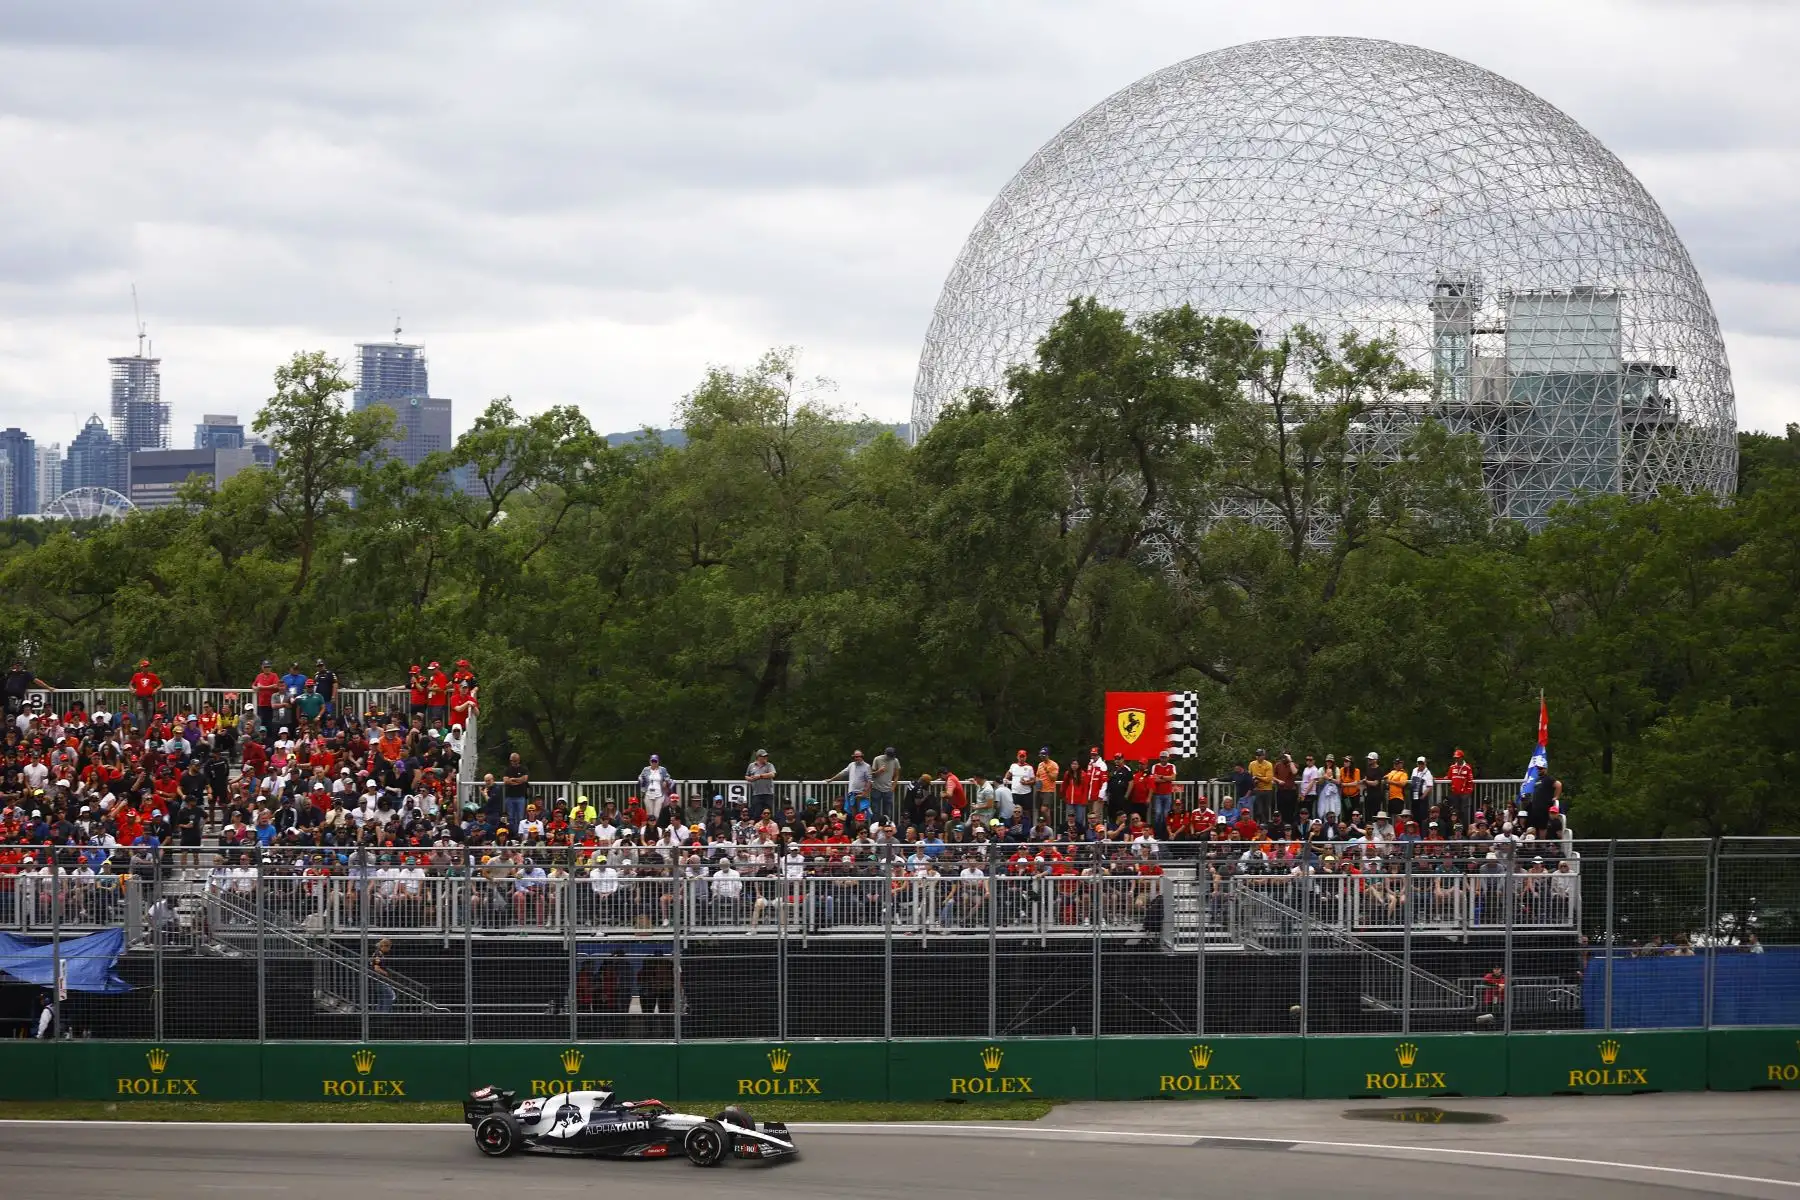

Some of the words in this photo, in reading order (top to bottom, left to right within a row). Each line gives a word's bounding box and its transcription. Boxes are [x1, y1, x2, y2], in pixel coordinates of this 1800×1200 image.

[31, 693, 43, 708] 8
[731, 785, 745, 801] 9
[1366, 1072, 1447, 1089] ROLEX
[1568, 1069, 1649, 1086] ROLEX
[1767, 1064, 1800, 1081] RO
[117, 1079, 198, 1095] ROLEX
[323, 1079, 405, 1096] ROLEX
[738, 1079, 821, 1096] ROLEX
[951, 1077, 1033, 1094] ROLEX
[1160, 1075, 1242, 1092] ROLEX
[585, 1120, 650, 1136] ALPHATAURI
